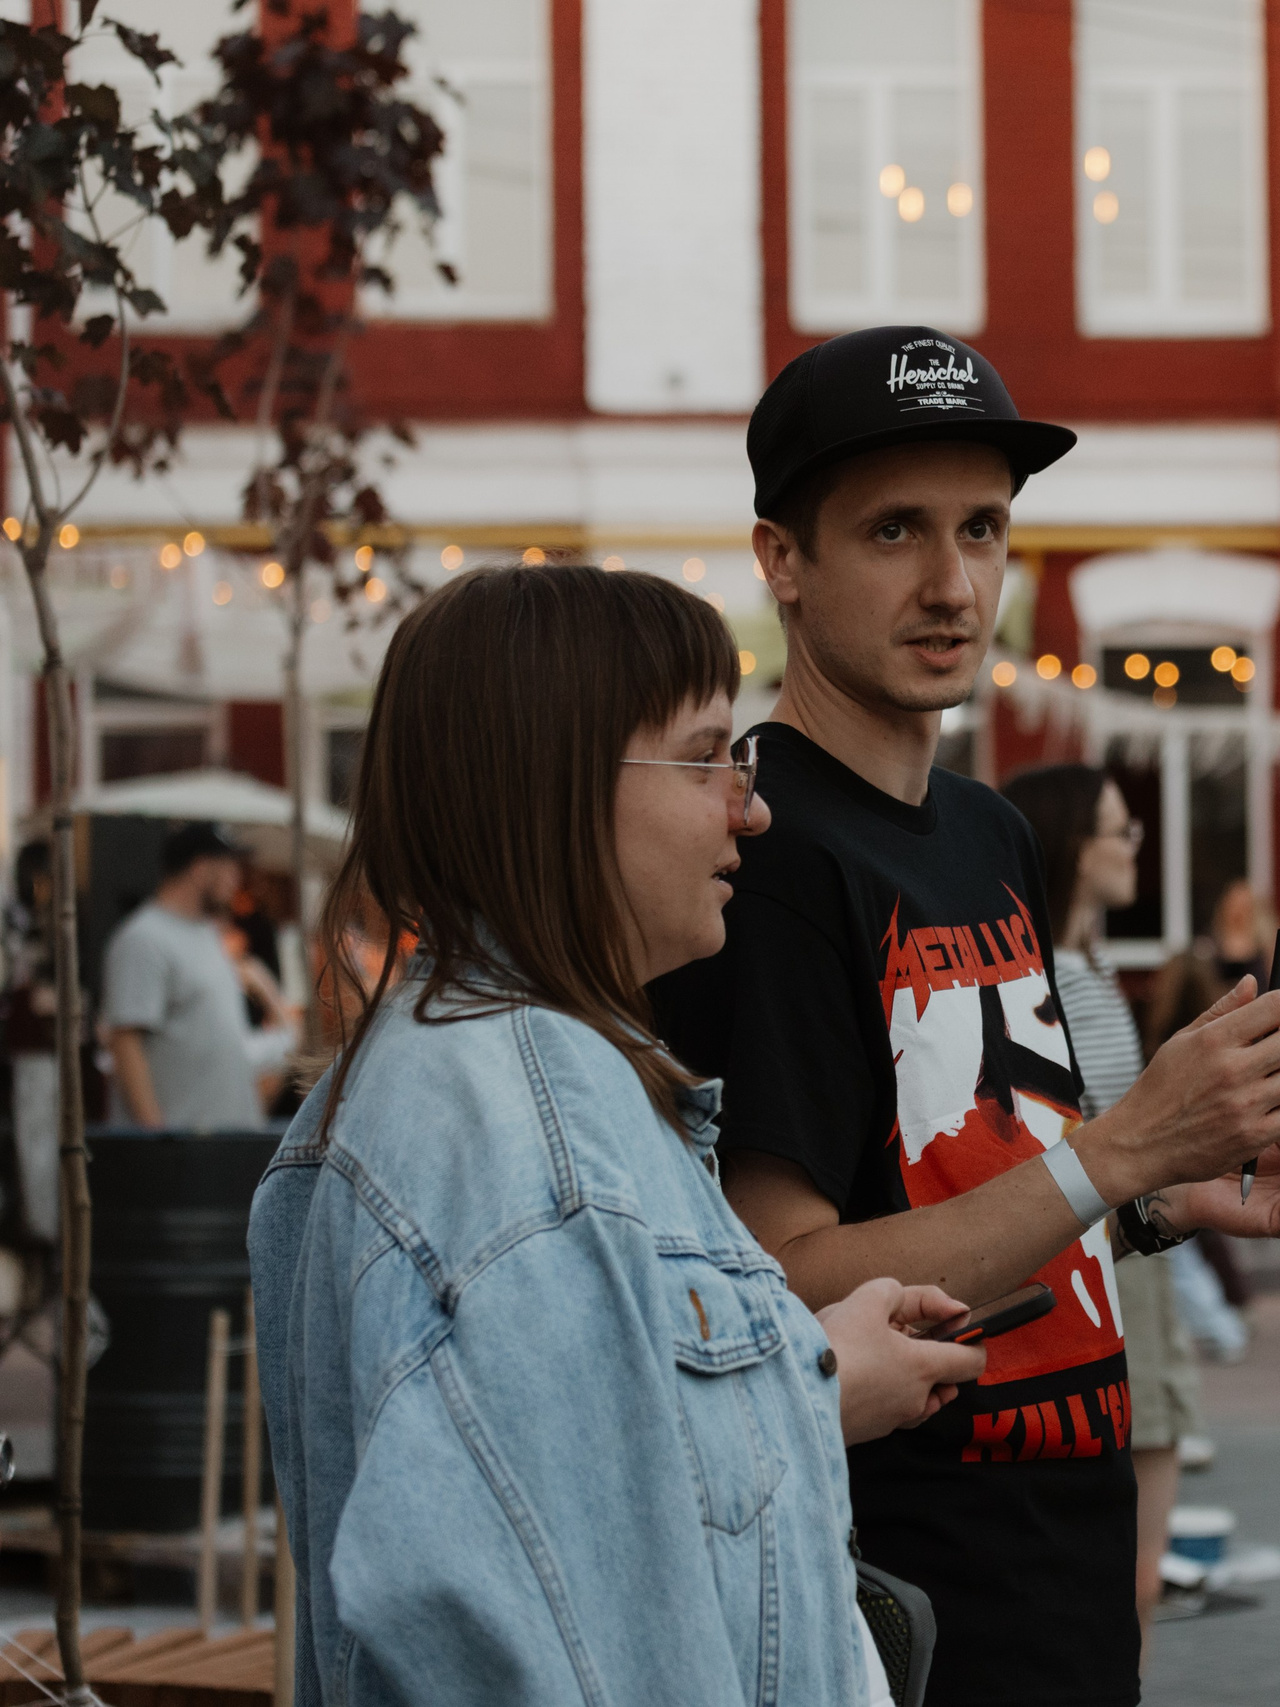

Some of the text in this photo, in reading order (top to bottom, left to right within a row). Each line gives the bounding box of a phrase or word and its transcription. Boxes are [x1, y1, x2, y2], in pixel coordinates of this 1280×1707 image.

[901, 342, 915, 352] THE
[914, 339, 934, 348] FINEST
[928, 358, 940, 366] THE
[886, 353, 979, 393] Herschel
[915, 382, 936, 390] SUPPLY
[917, 398, 967, 406] TRADE MARK
[961, 1393, 1102, 1463] KILL
